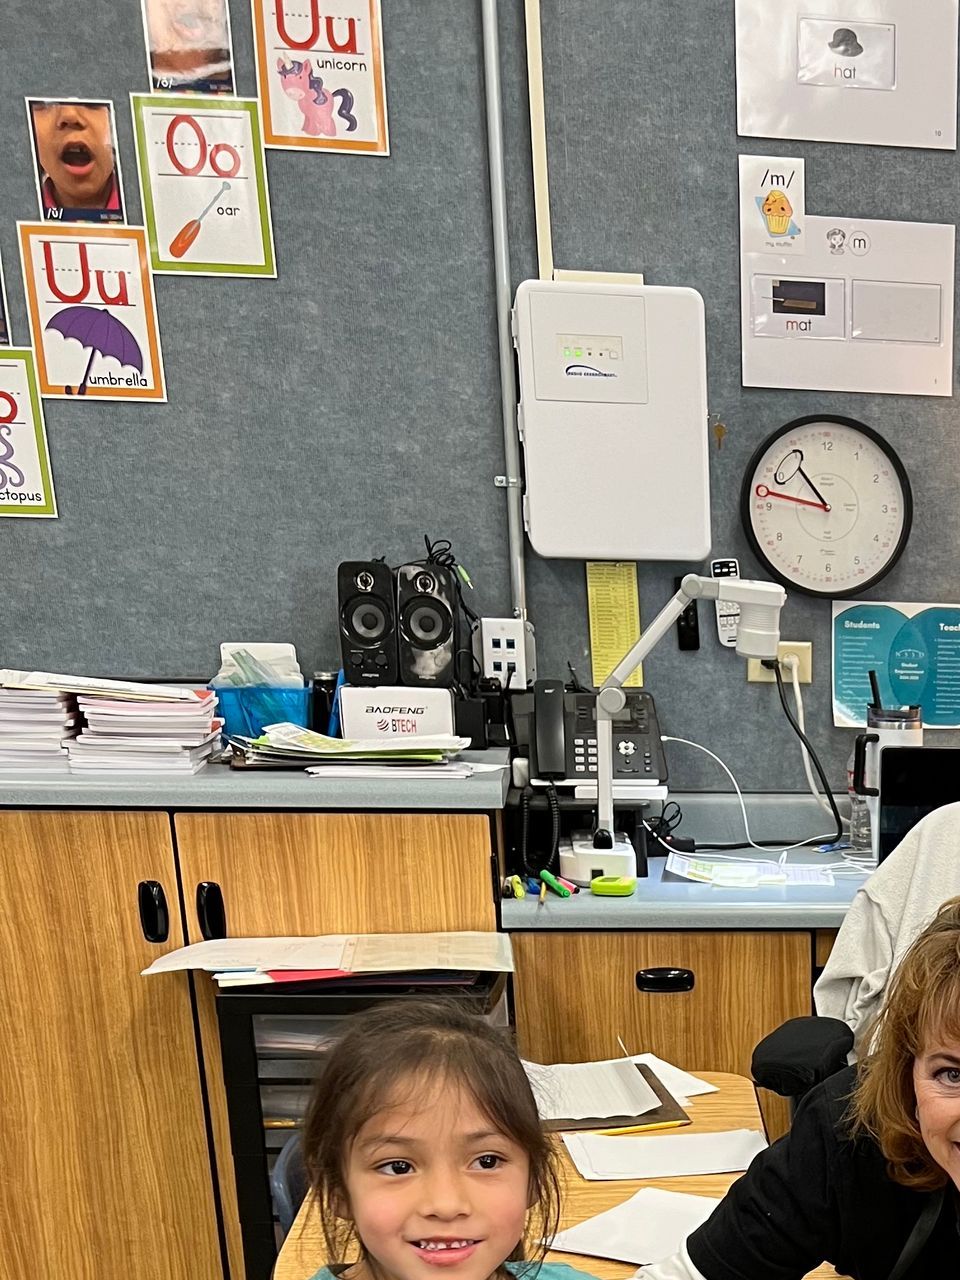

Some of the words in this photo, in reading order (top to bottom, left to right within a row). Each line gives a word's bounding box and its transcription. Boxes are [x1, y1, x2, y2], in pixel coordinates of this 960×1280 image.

[276, 0, 358, 53] Uu
[316, 57, 367, 73] unicorn
[833, 65, 857, 80] hat
[166, 114, 241, 178] Oo
[761, 169, 795, 188] /m/
[217, 204, 240, 217] oar
[853, 237, 866, 249] m
[44, 242, 129, 305] Uu
[786, 318, 811, 332] mat
[89, 372, 148, 387] umbrella
[822, 442, 833, 450] 12
[873, 474, 879, 483] 2
[0, 489, 42, 503] ctopus
[766, 503, 772, 511] 9
[882, 505, 888, 513] 3
[777, 533, 782, 541] 8
[797, 555, 803, 563] 7
[825, 564, 831, 572] 6
[844, 620, 880, 629] Students
[365, 705, 425, 715] BAOFENG
[391, 719, 417, 733] BTECH
